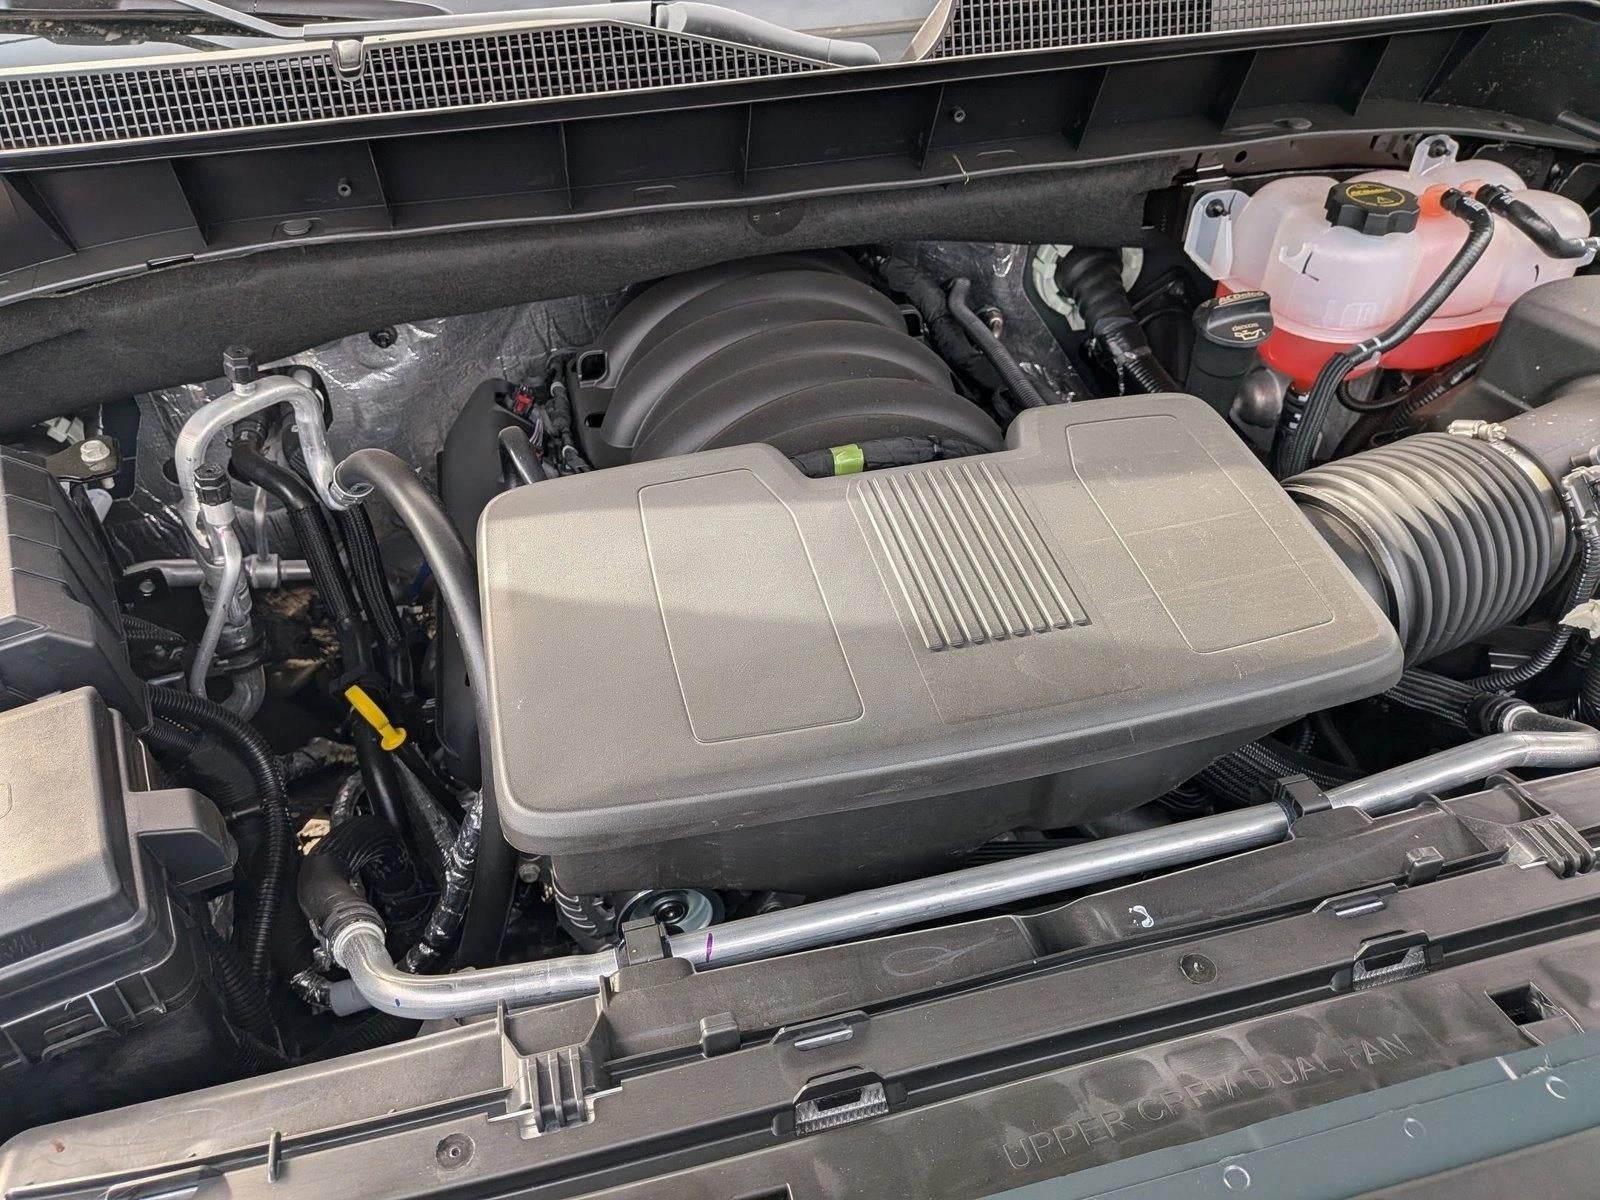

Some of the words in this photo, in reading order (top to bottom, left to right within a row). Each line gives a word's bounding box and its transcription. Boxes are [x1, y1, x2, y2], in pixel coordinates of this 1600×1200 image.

[1219, 291, 1264, 306] ACDelco
[1003, 1111, 1135, 1170] UPPER
[1243, 1053, 1343, 1090] DUAL
[1346, 1033, 1414, 1069] FAN
